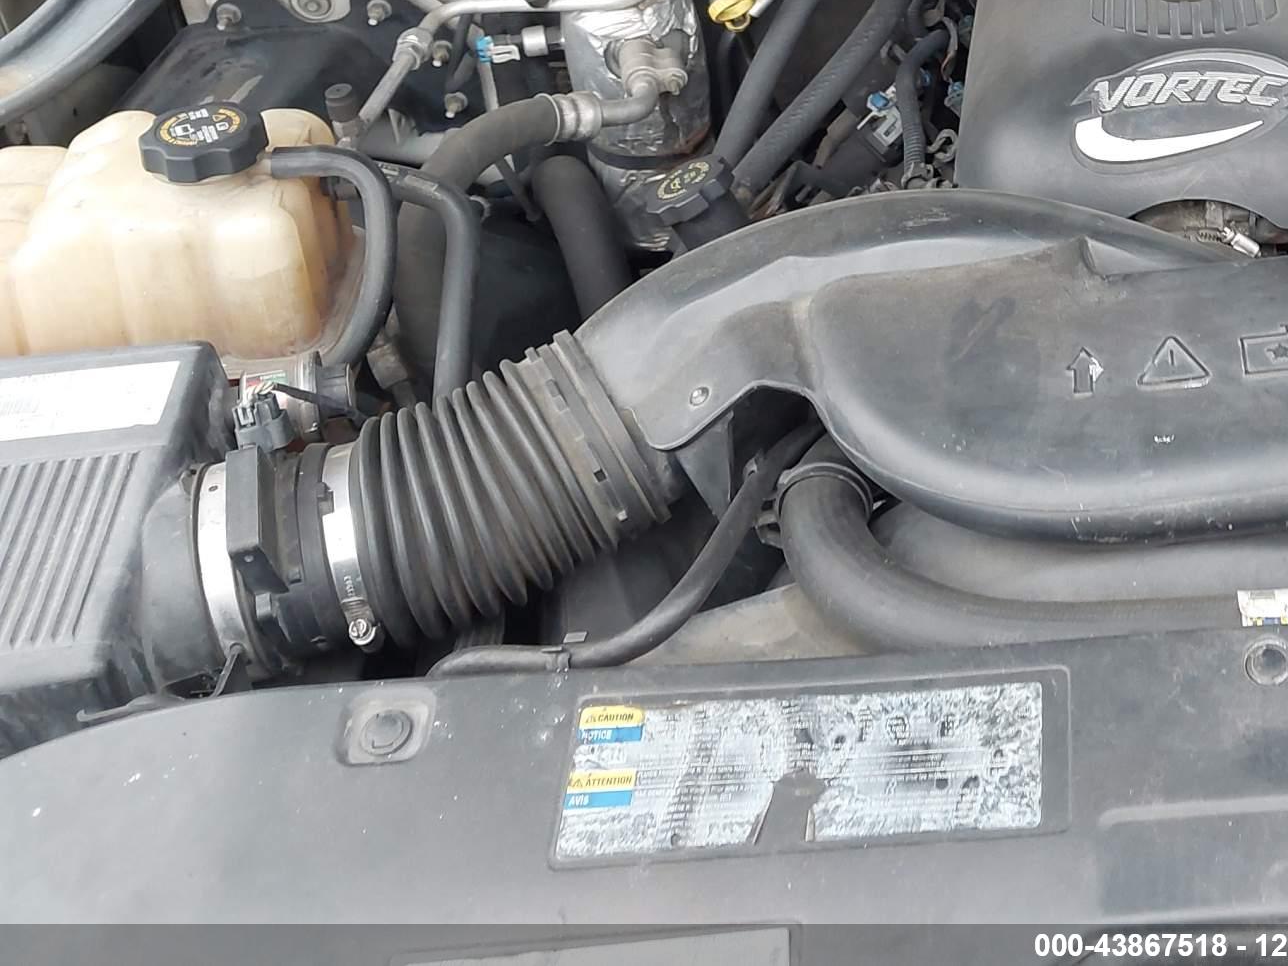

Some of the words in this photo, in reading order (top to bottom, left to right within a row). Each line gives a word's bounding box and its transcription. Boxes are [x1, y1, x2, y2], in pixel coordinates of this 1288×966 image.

[598, 713, 634, 722] CAUTION
[585, 777, 632, 787] ATTENTION
[568, 795, 590, 806] AVIS
